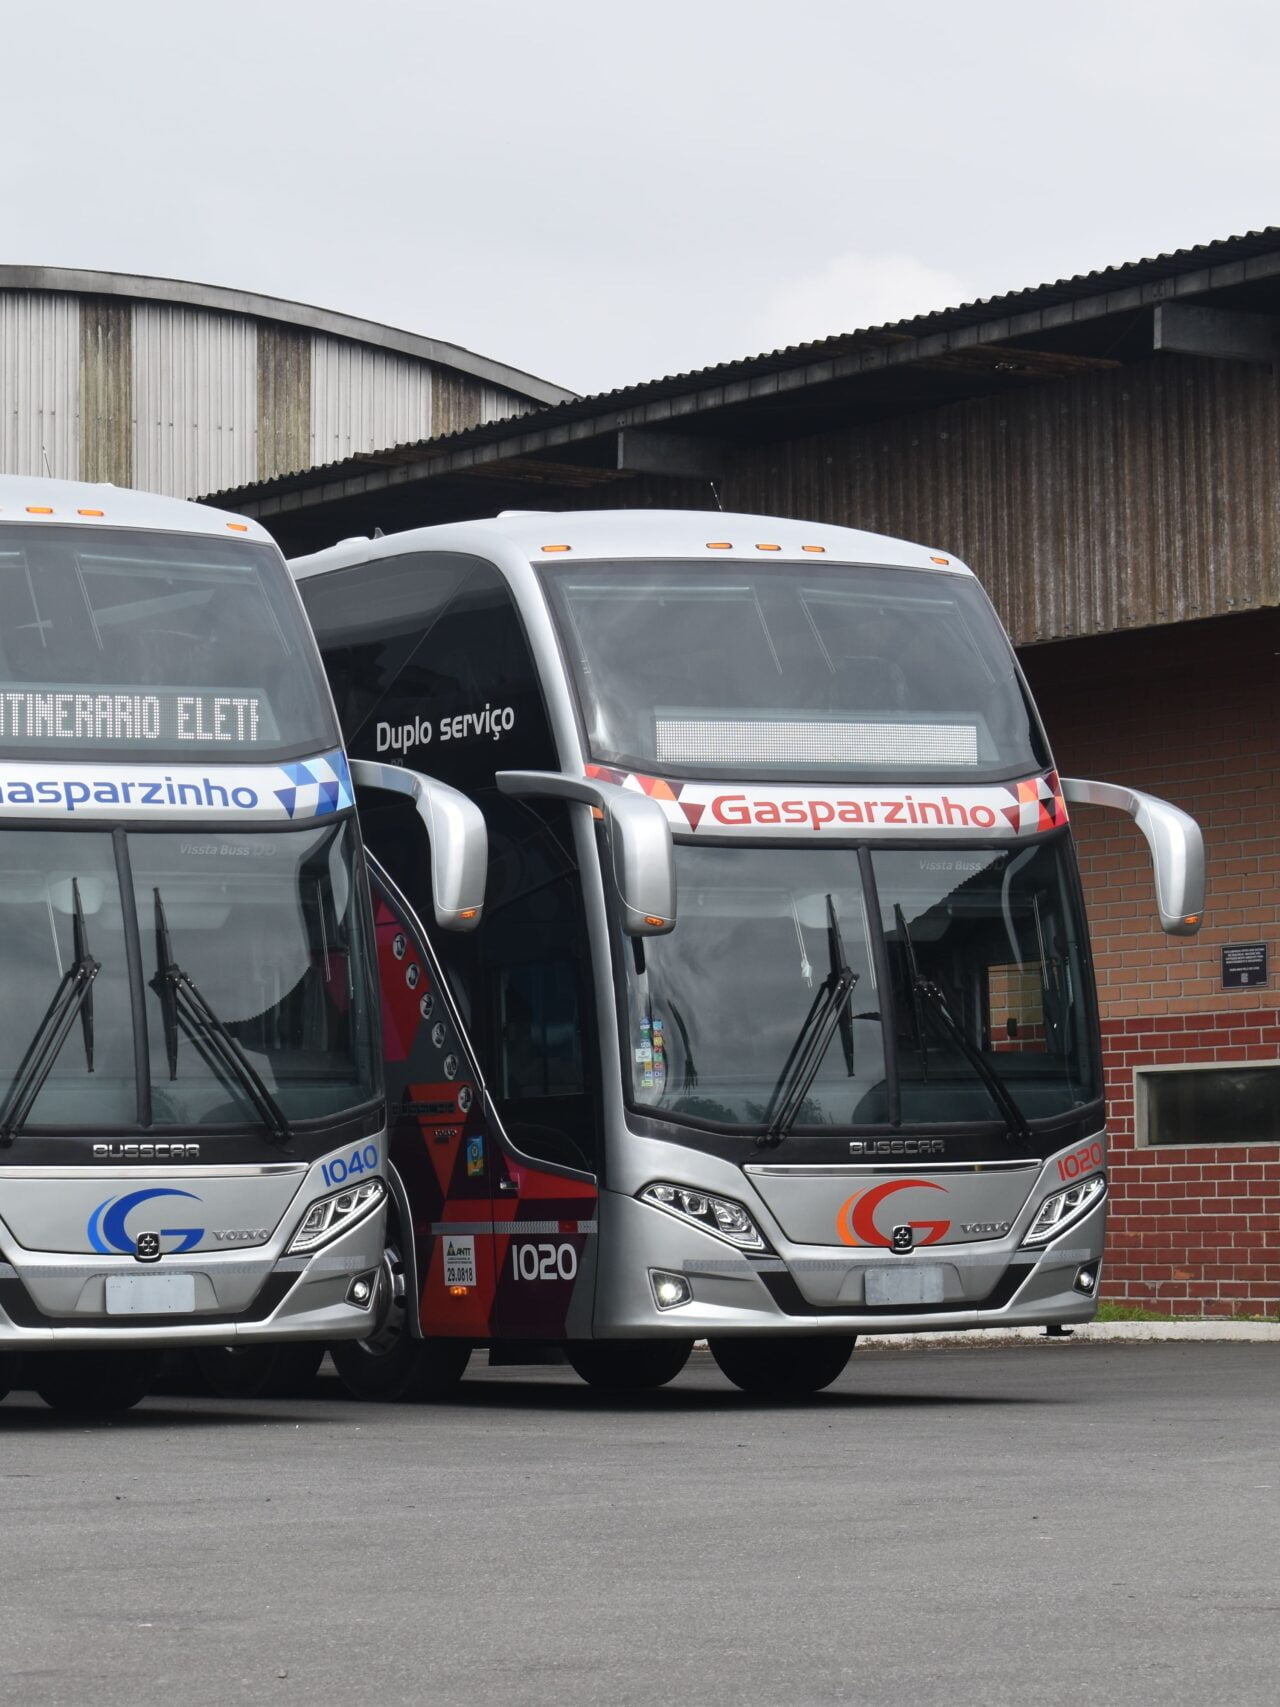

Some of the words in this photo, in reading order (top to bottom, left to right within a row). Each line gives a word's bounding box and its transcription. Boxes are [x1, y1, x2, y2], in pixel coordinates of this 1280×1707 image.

[376, 716, 432, 755] Duplo
[440, 703, 515, 741] serviço
[711, 794, 996, 831] Gasparzinho
[179, 843, 217, 855] Vissta
[220, 844, 250, 856] Buss
[919, 860, 953, 870] Vissta
[955, 860, 982, 871] Buss
[92, 1144, 200, 1158] BUSSCAR
[849, 1140, 945, 1155] BUSSCAR
[321, 1144, 379, 1188] 1040
[1057, 1141, 1103, 1182] 1020
[212, 1228, 270, 1242] VOLVO
[960, 1222, 1010, 1234] VOLVO
[455, 1247, 471, 1256] ANTT
[512, 1243, 577, 1280] 1020
[447, 1267, 473, 1282] 29.0818
